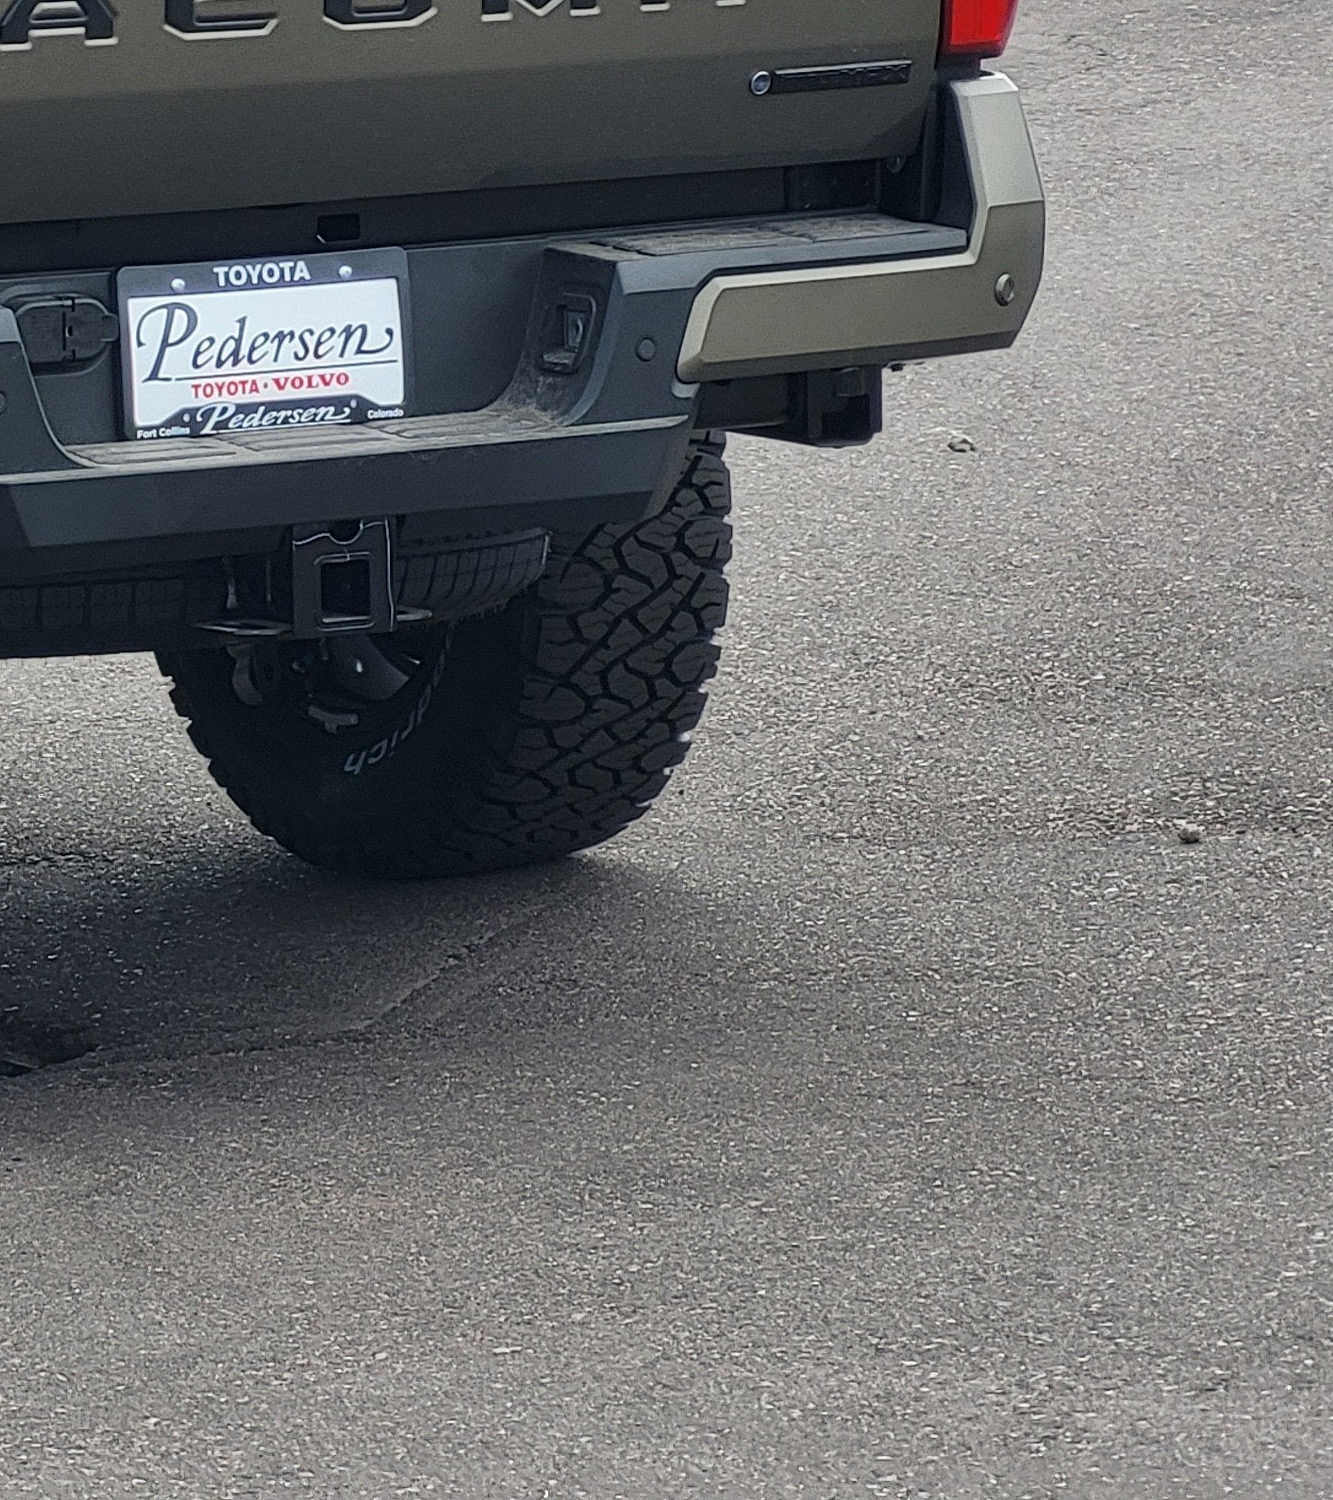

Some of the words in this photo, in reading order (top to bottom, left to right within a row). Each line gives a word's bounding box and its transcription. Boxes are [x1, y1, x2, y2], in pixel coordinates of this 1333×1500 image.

[213, 260, 311, 288] TOYOTA
[135, 301, 395, 383] Pedersen
[191, 380, 260, 399] TOYOTA
[271, 371, 350, 392] VOLVO
[195, 401, 352, 435] Pedersen
[367, 407, 404, 420] Colorado
[136, 429, 157, 440] Fort
[159, 425, 190, 438] Collins
